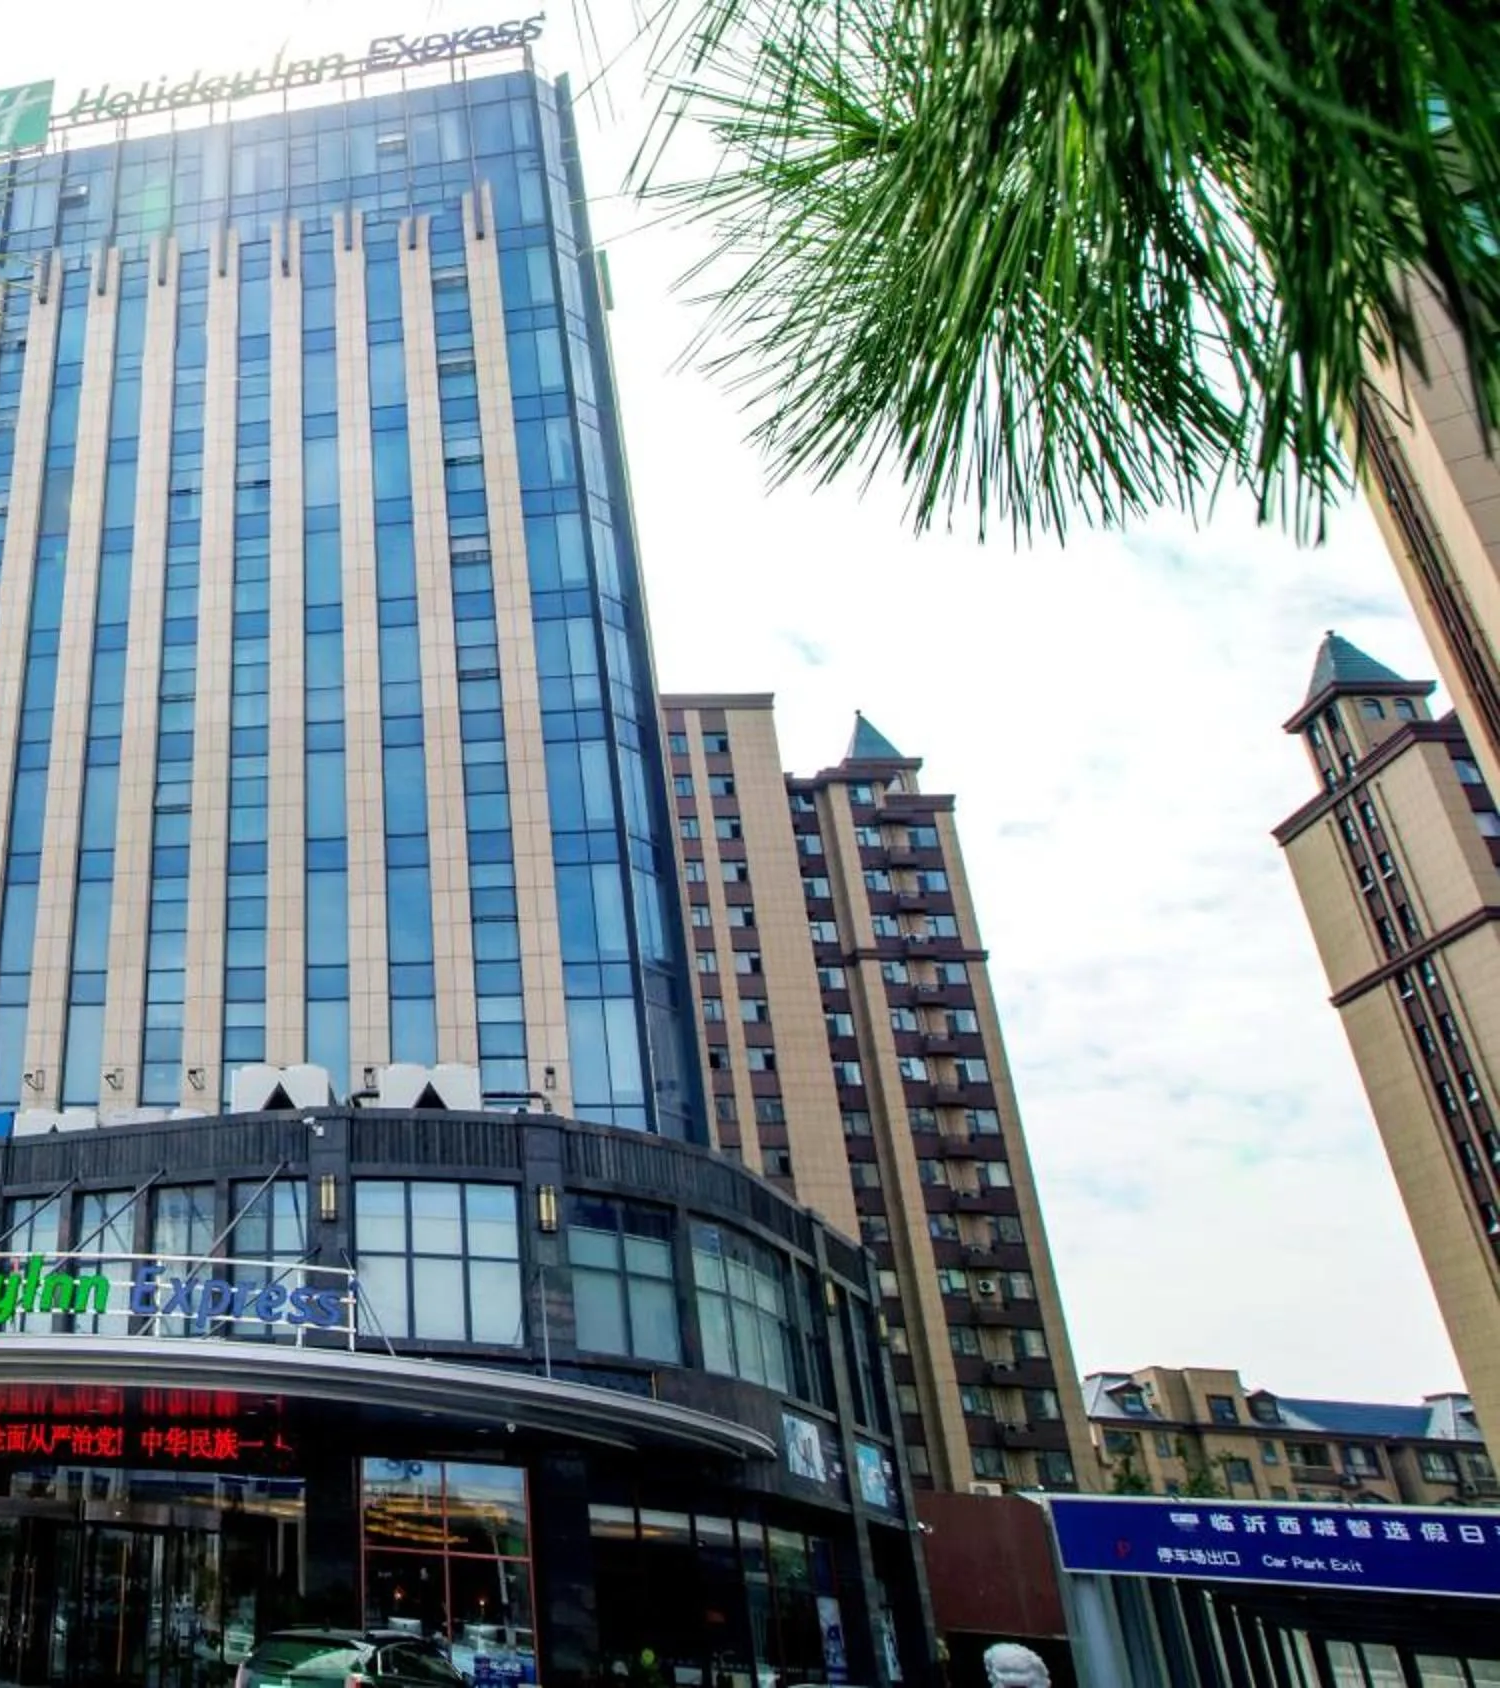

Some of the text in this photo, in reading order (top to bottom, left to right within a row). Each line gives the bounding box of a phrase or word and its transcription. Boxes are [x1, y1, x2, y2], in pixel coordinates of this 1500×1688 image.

[363, 14, 545, 71] Express
[130, 1264, 345, 1329] Express
[1209, 1513, 1500, 1544] 临沂西城智选假日
[1157, 1547, 1241, 1567] 停车场出口
[1262, 1554, 1365, 1574] Car Park Exit
